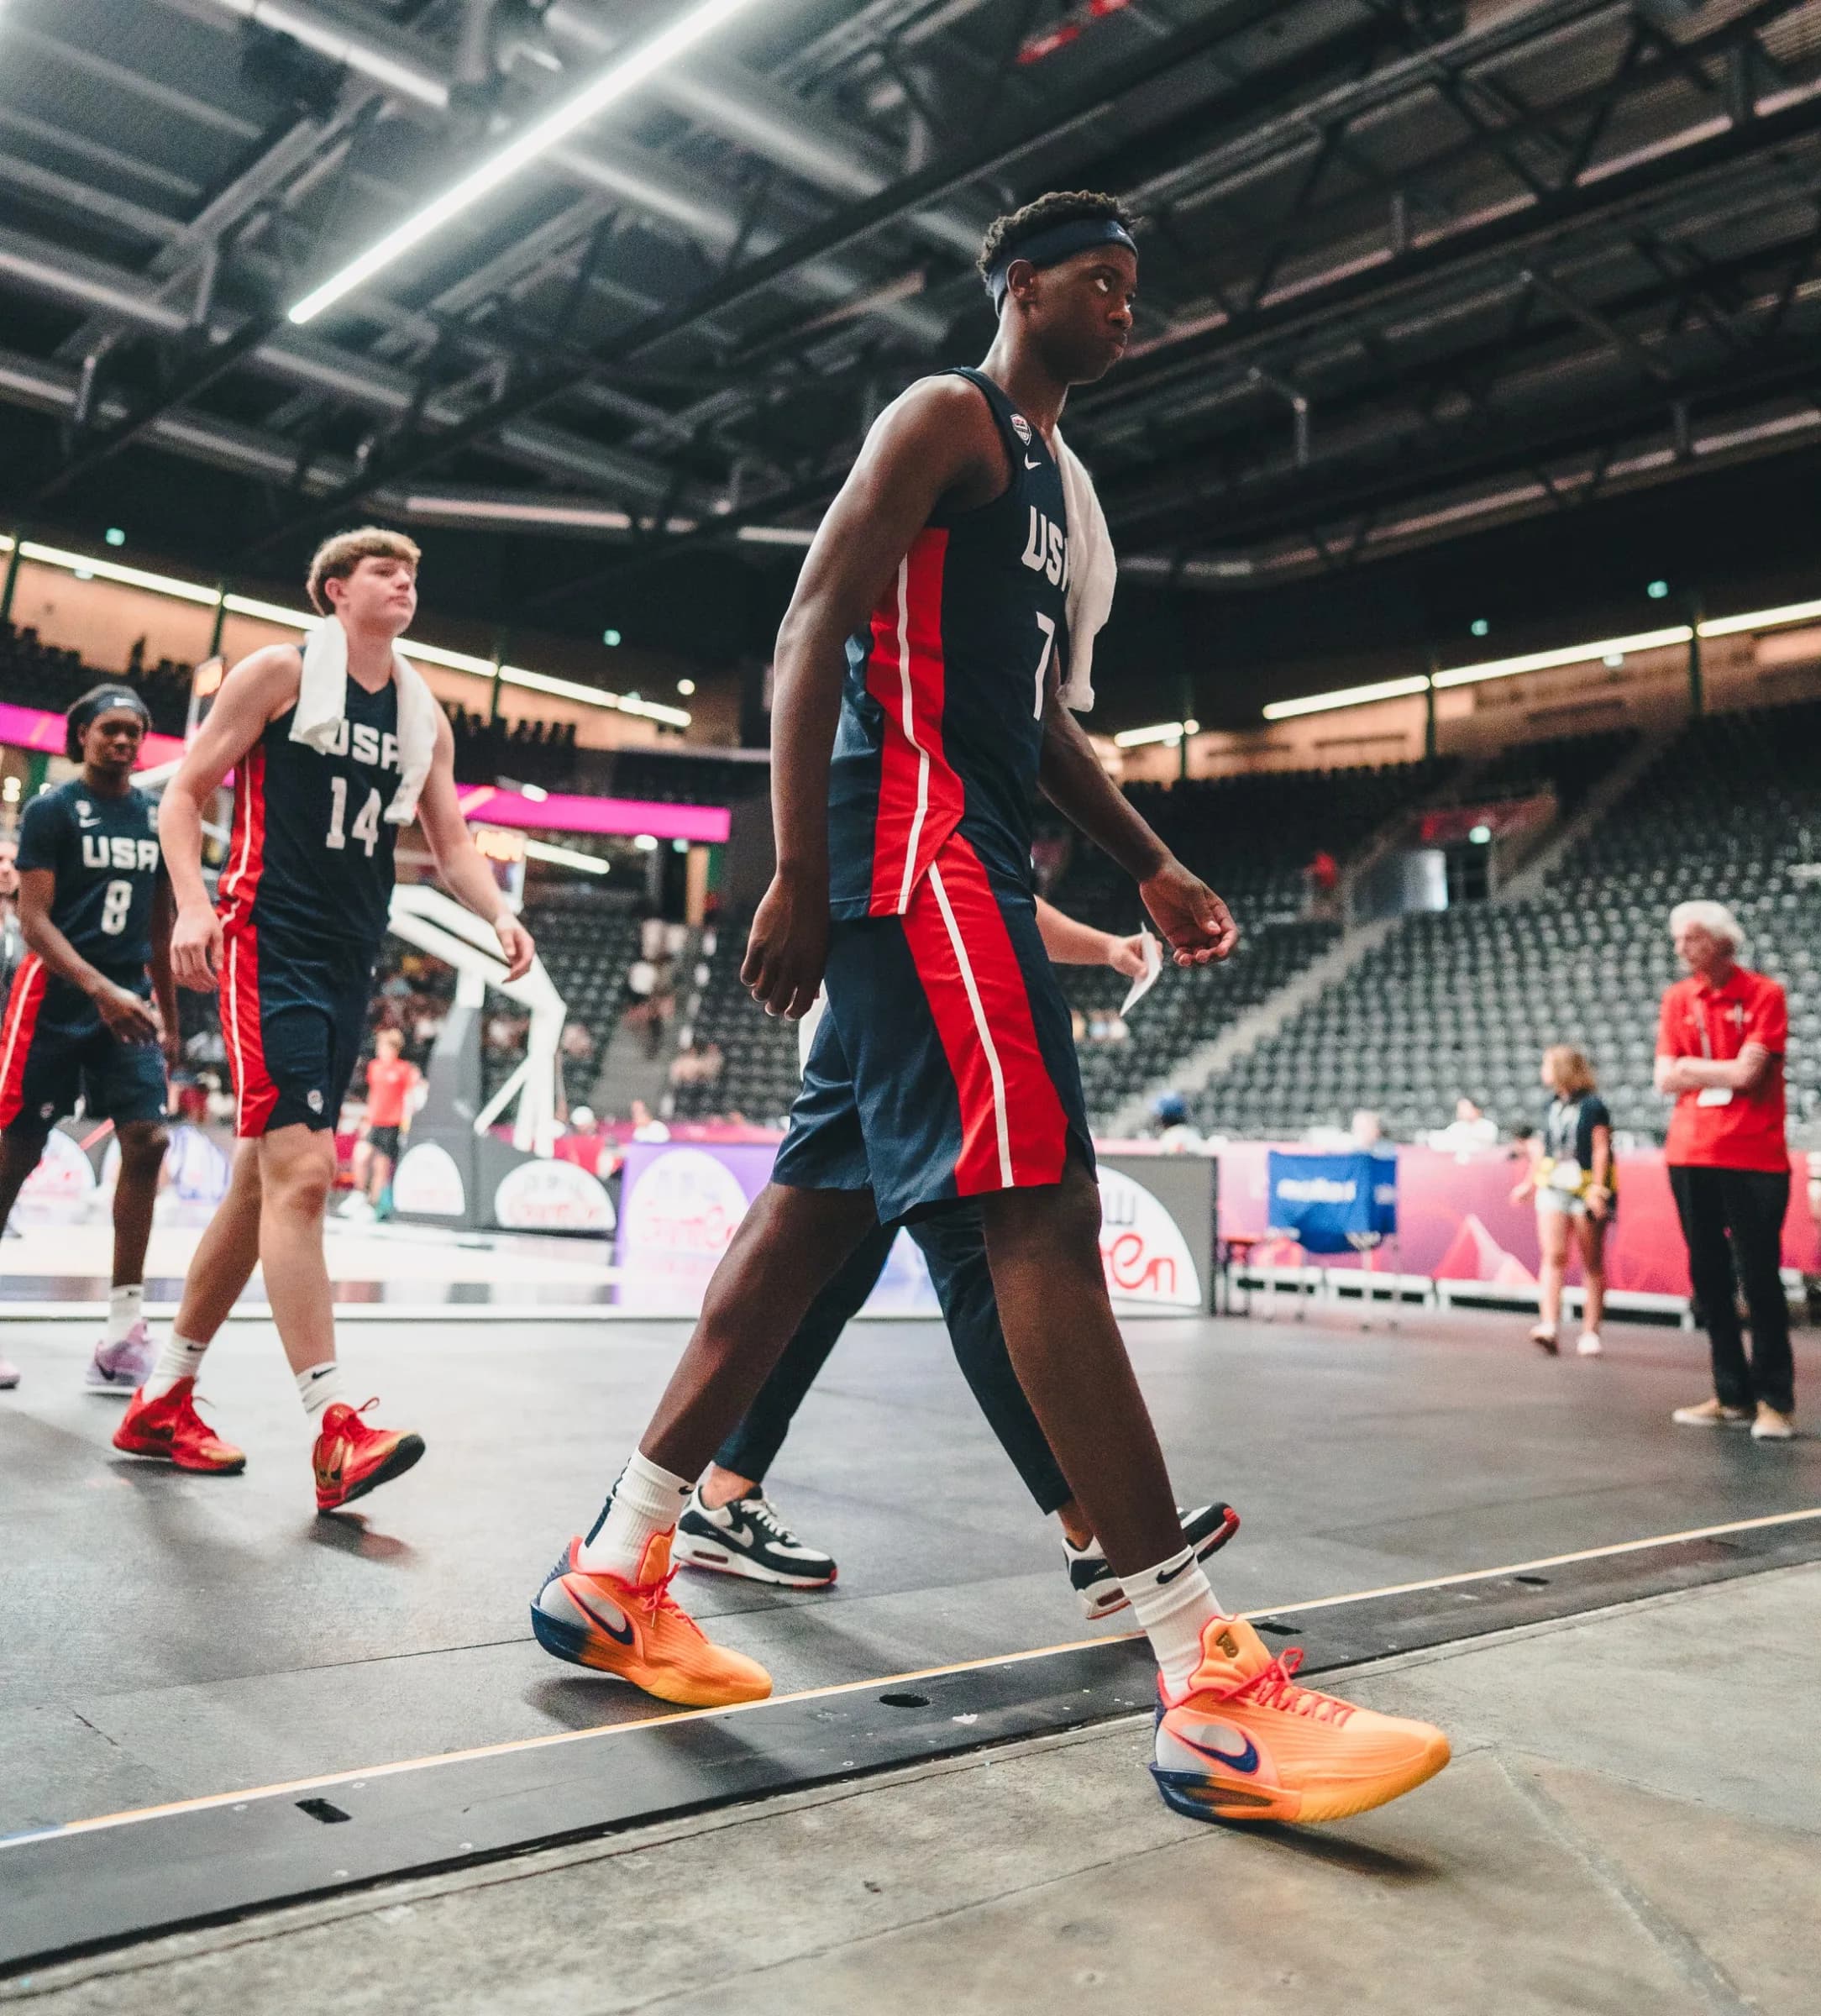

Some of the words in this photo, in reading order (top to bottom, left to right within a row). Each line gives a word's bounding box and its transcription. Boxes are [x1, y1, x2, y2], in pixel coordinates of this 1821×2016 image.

[1021, 504, 1069, 592] US
[1032, 611, 1056, 722] 7
[81, 834, 160, 874] USA
[325, 775, 382, 858] 14
[100, 879, 133, 936] 8
